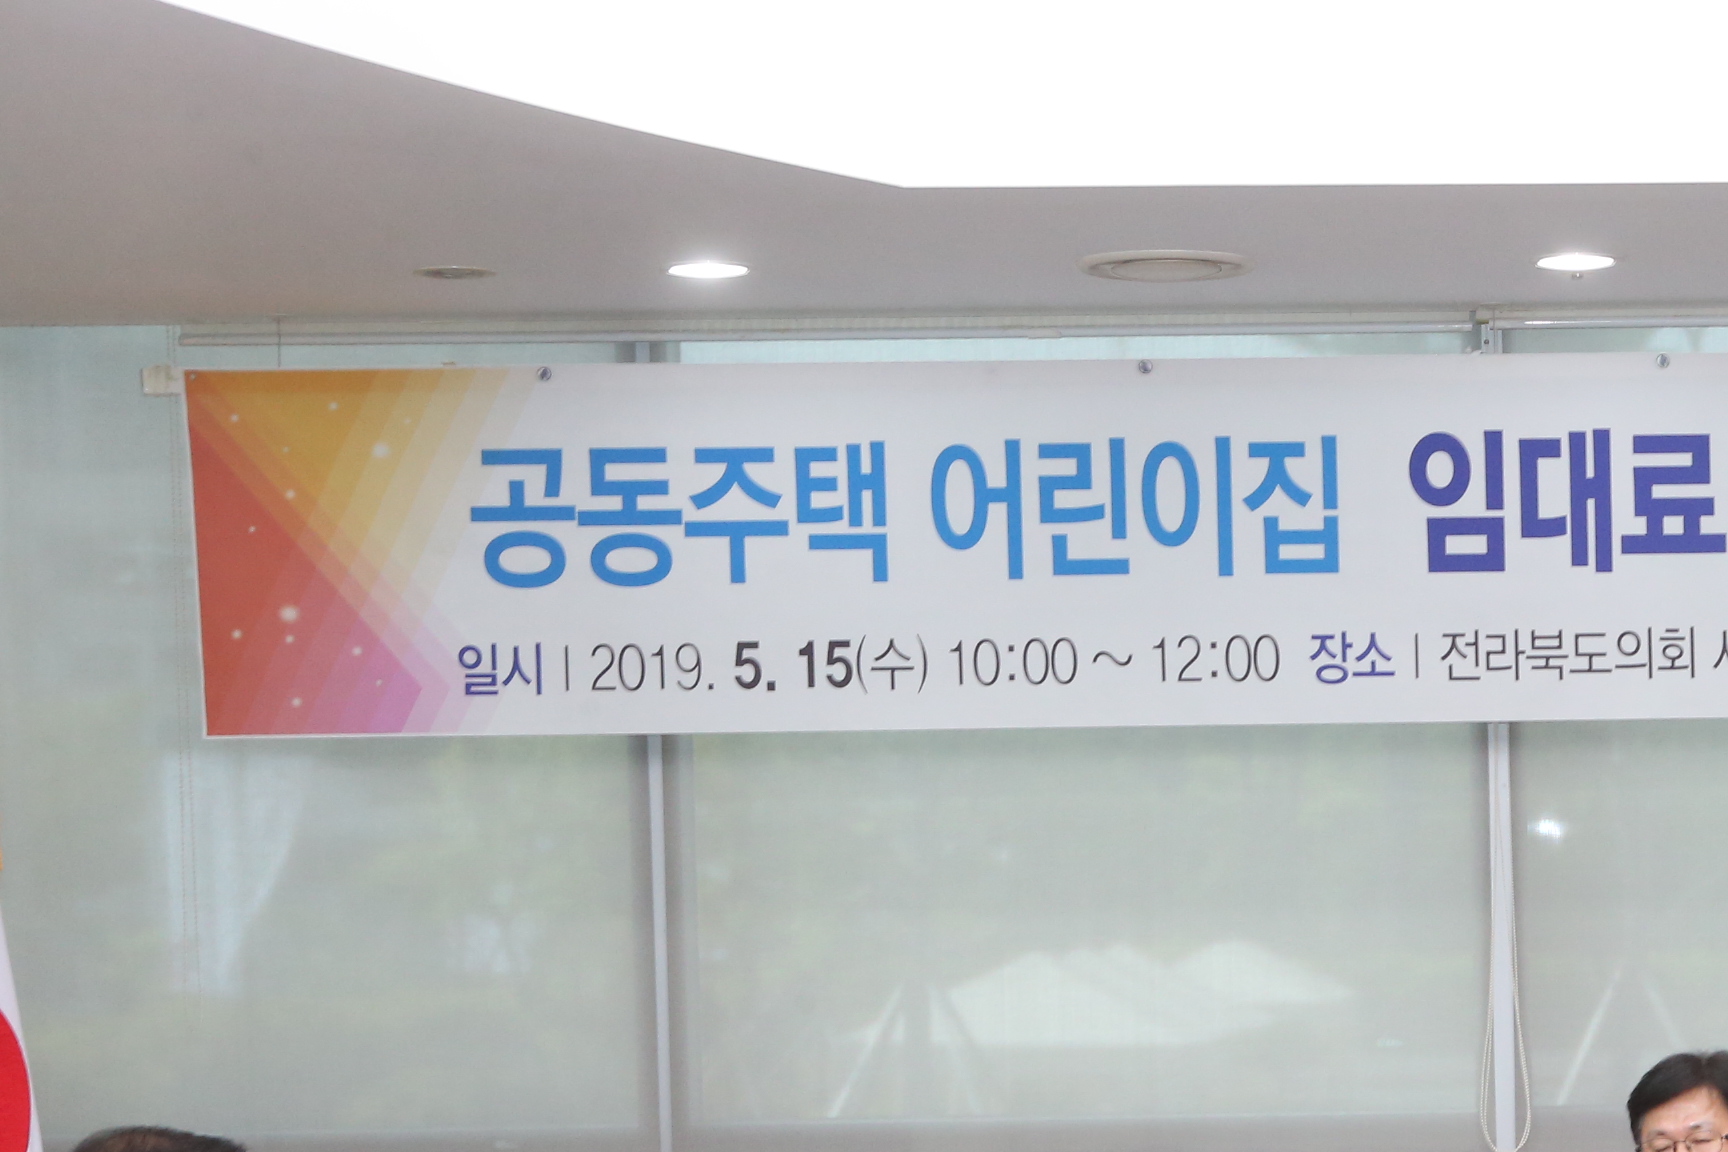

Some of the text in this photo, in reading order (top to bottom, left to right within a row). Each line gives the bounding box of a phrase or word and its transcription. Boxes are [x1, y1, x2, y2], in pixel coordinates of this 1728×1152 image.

[469, 440, 889, 589] 공동주택
[930, 435, 1340, 580] 어린이집
[1408, 427, 1728, 574] 임대료
[457, 641, 543, 697] 일시
[590, 642, 715, 692] 2019.
[734, 640, 777, 692] 5.
[798, 634, 929, 694] 15(수)
[949, 636, 1079, 687] 10:00
[1152, 633, 1281, 683] 12:00
[1309, 630, 1396, 685] 장소
[1440, 625, 1696, 682] 전라북도의회
